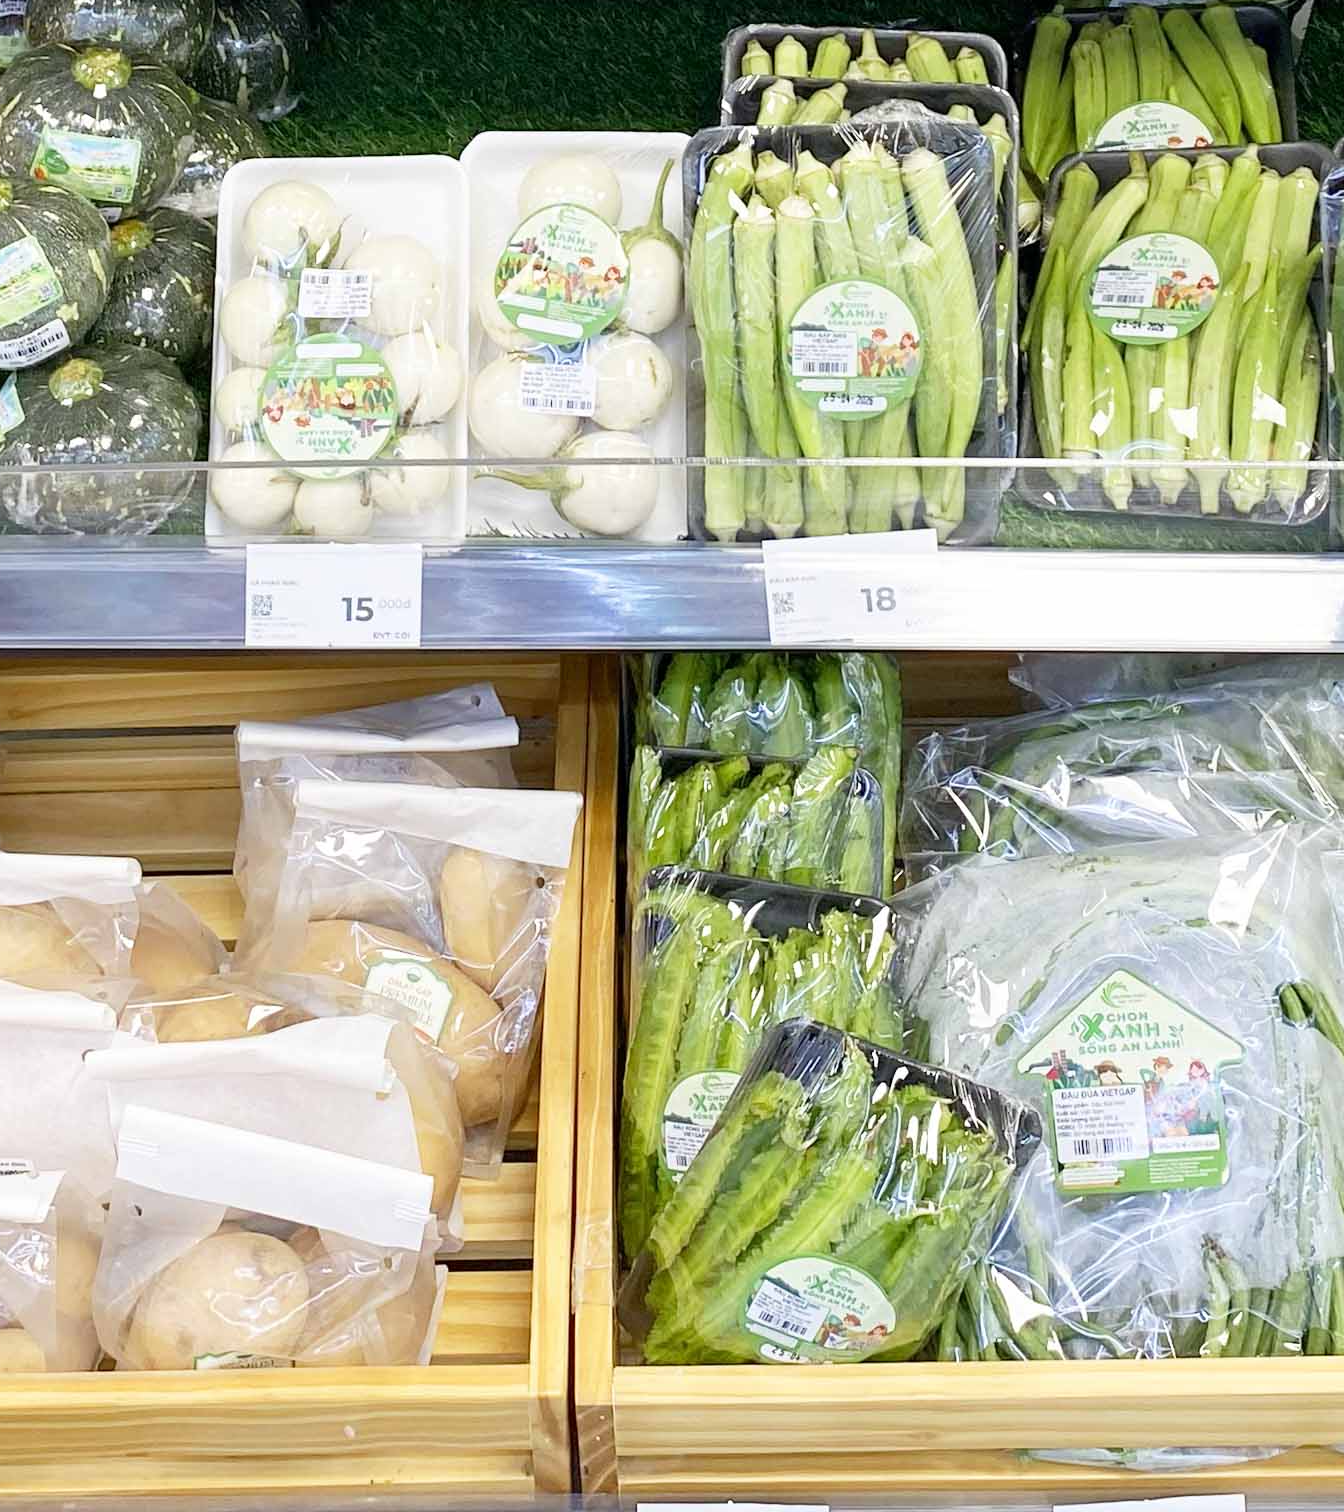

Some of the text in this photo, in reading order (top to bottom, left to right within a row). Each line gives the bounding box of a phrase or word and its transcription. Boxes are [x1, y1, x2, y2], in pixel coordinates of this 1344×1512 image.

[342, 598, 373, 621] 15
[861, 586, 897, 614] 18
[1121, 1042, 1141, 1053] AN
